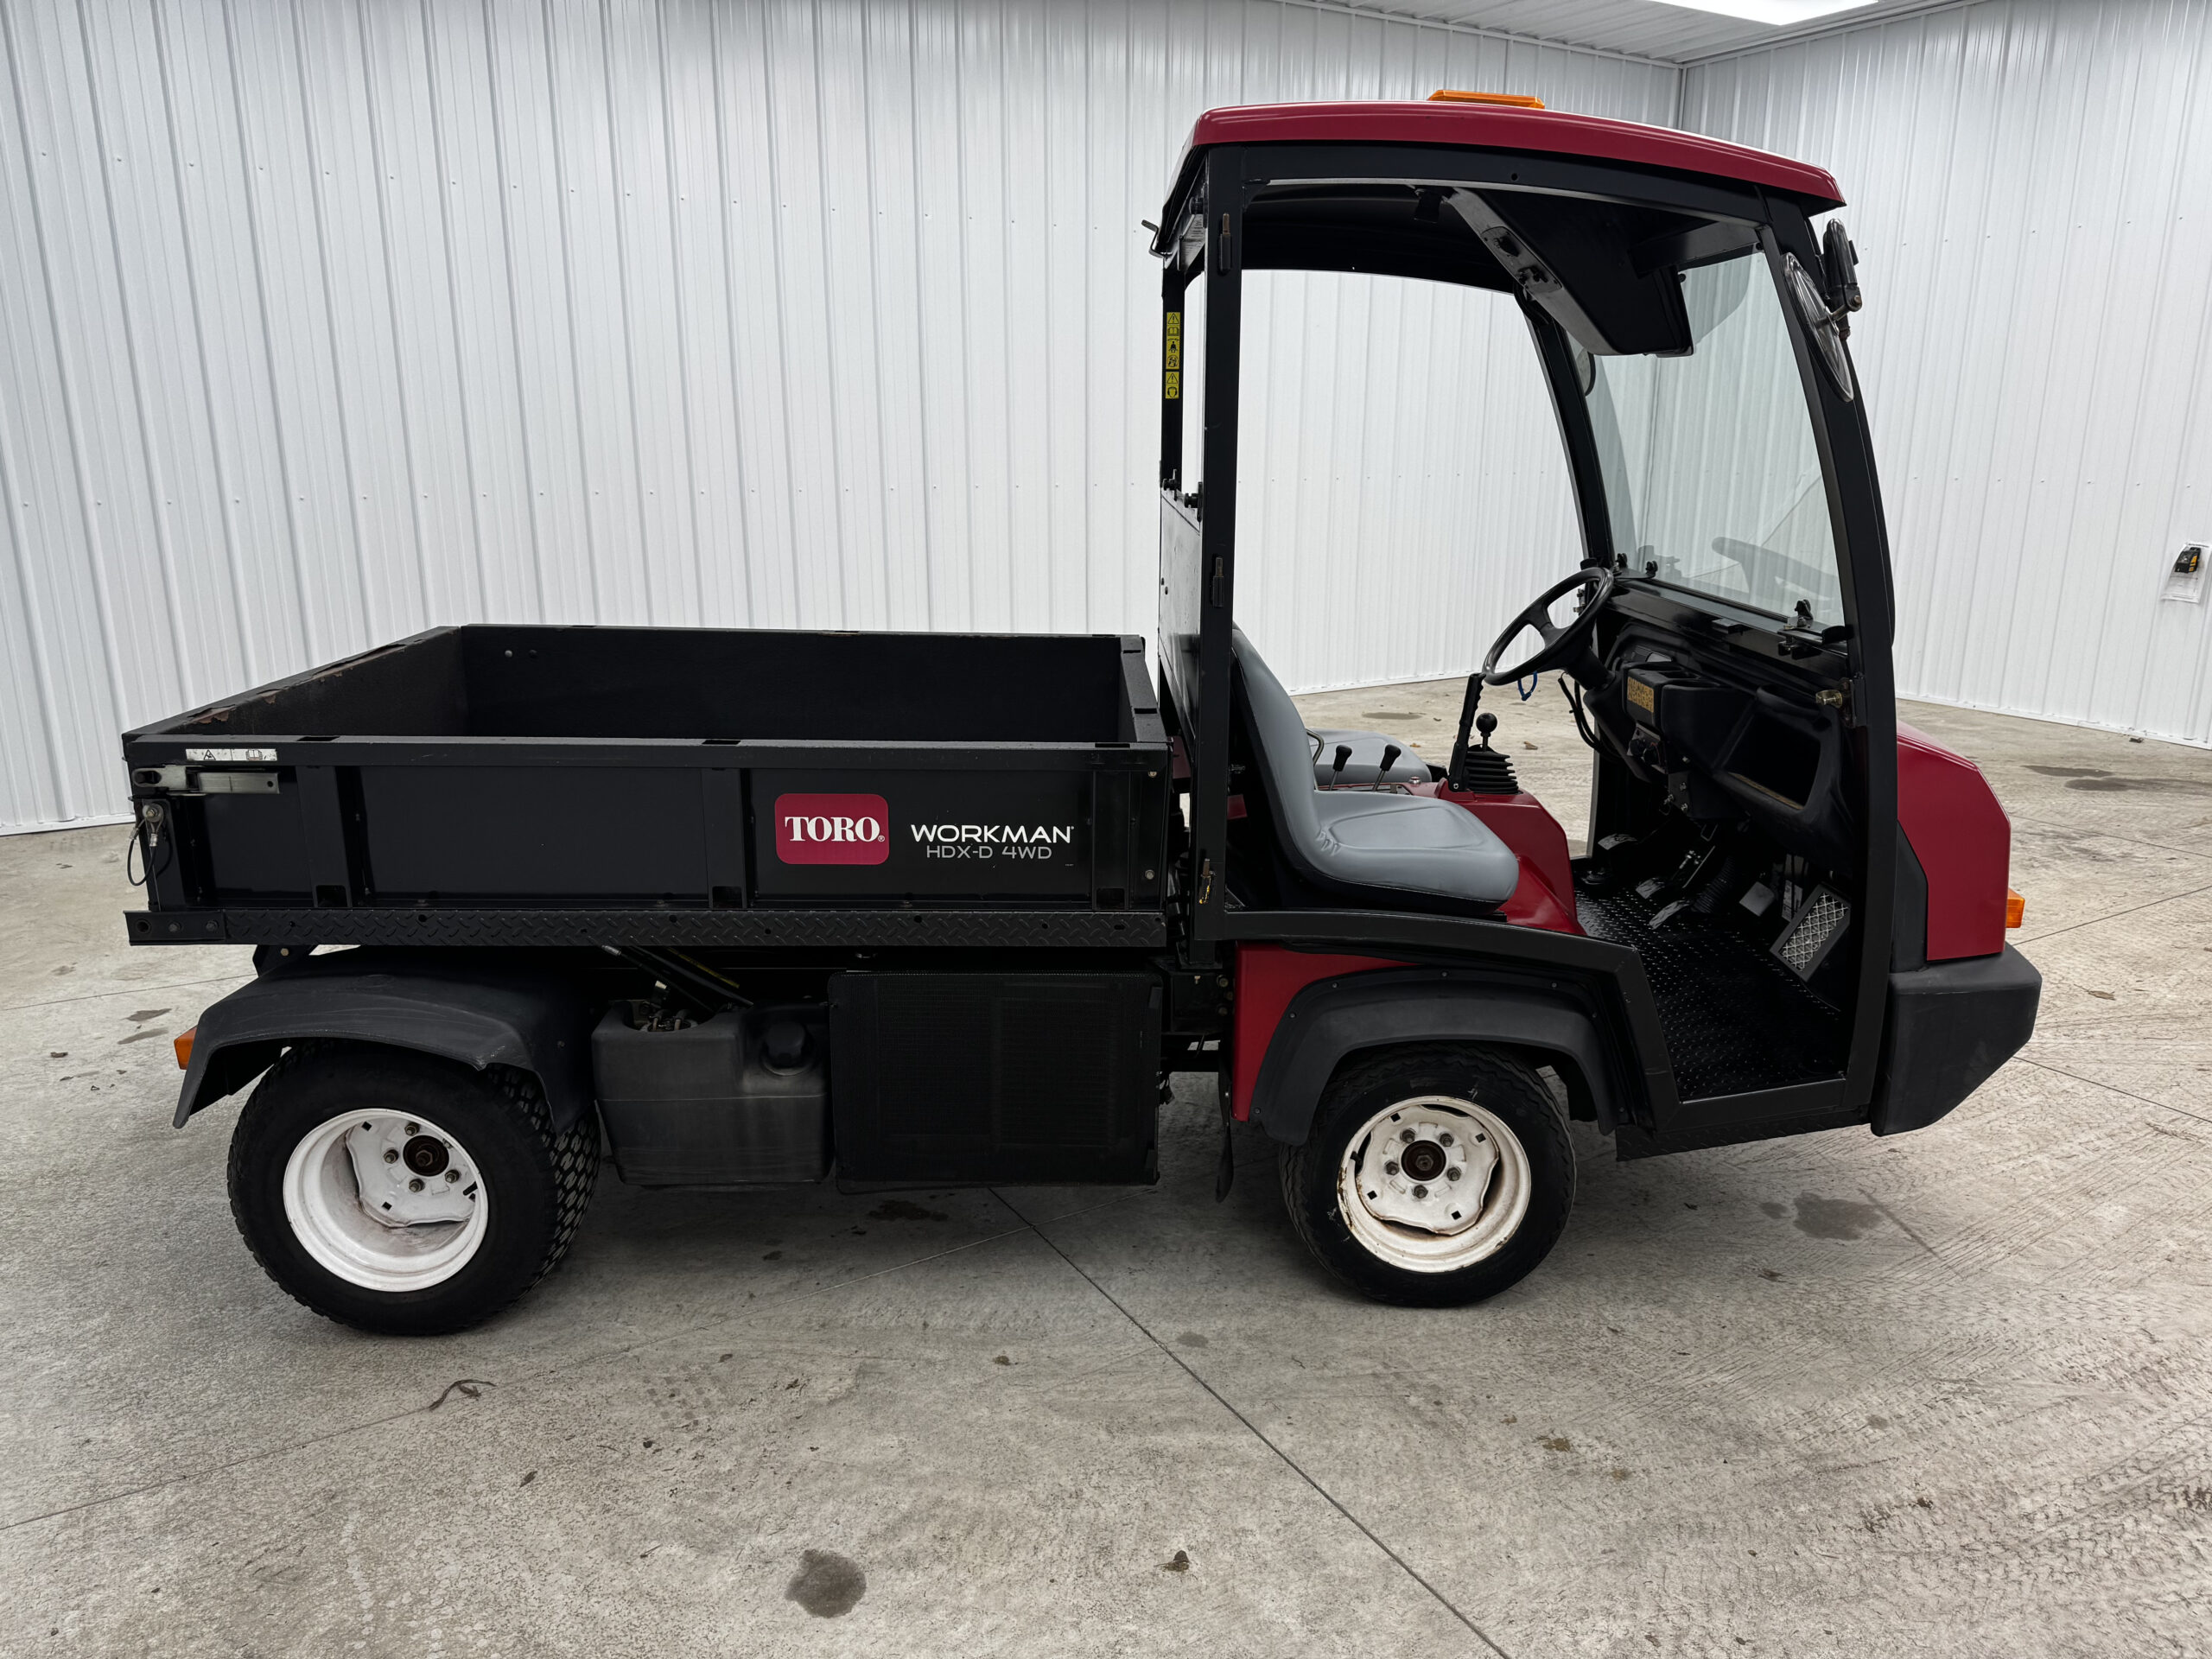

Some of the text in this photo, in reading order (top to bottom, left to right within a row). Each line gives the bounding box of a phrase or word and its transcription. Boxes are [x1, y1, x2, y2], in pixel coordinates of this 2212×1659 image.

[910, 824, 1071, 844] WORKMAN
[926, 845, 1052, 860] HDX-D 4WD
